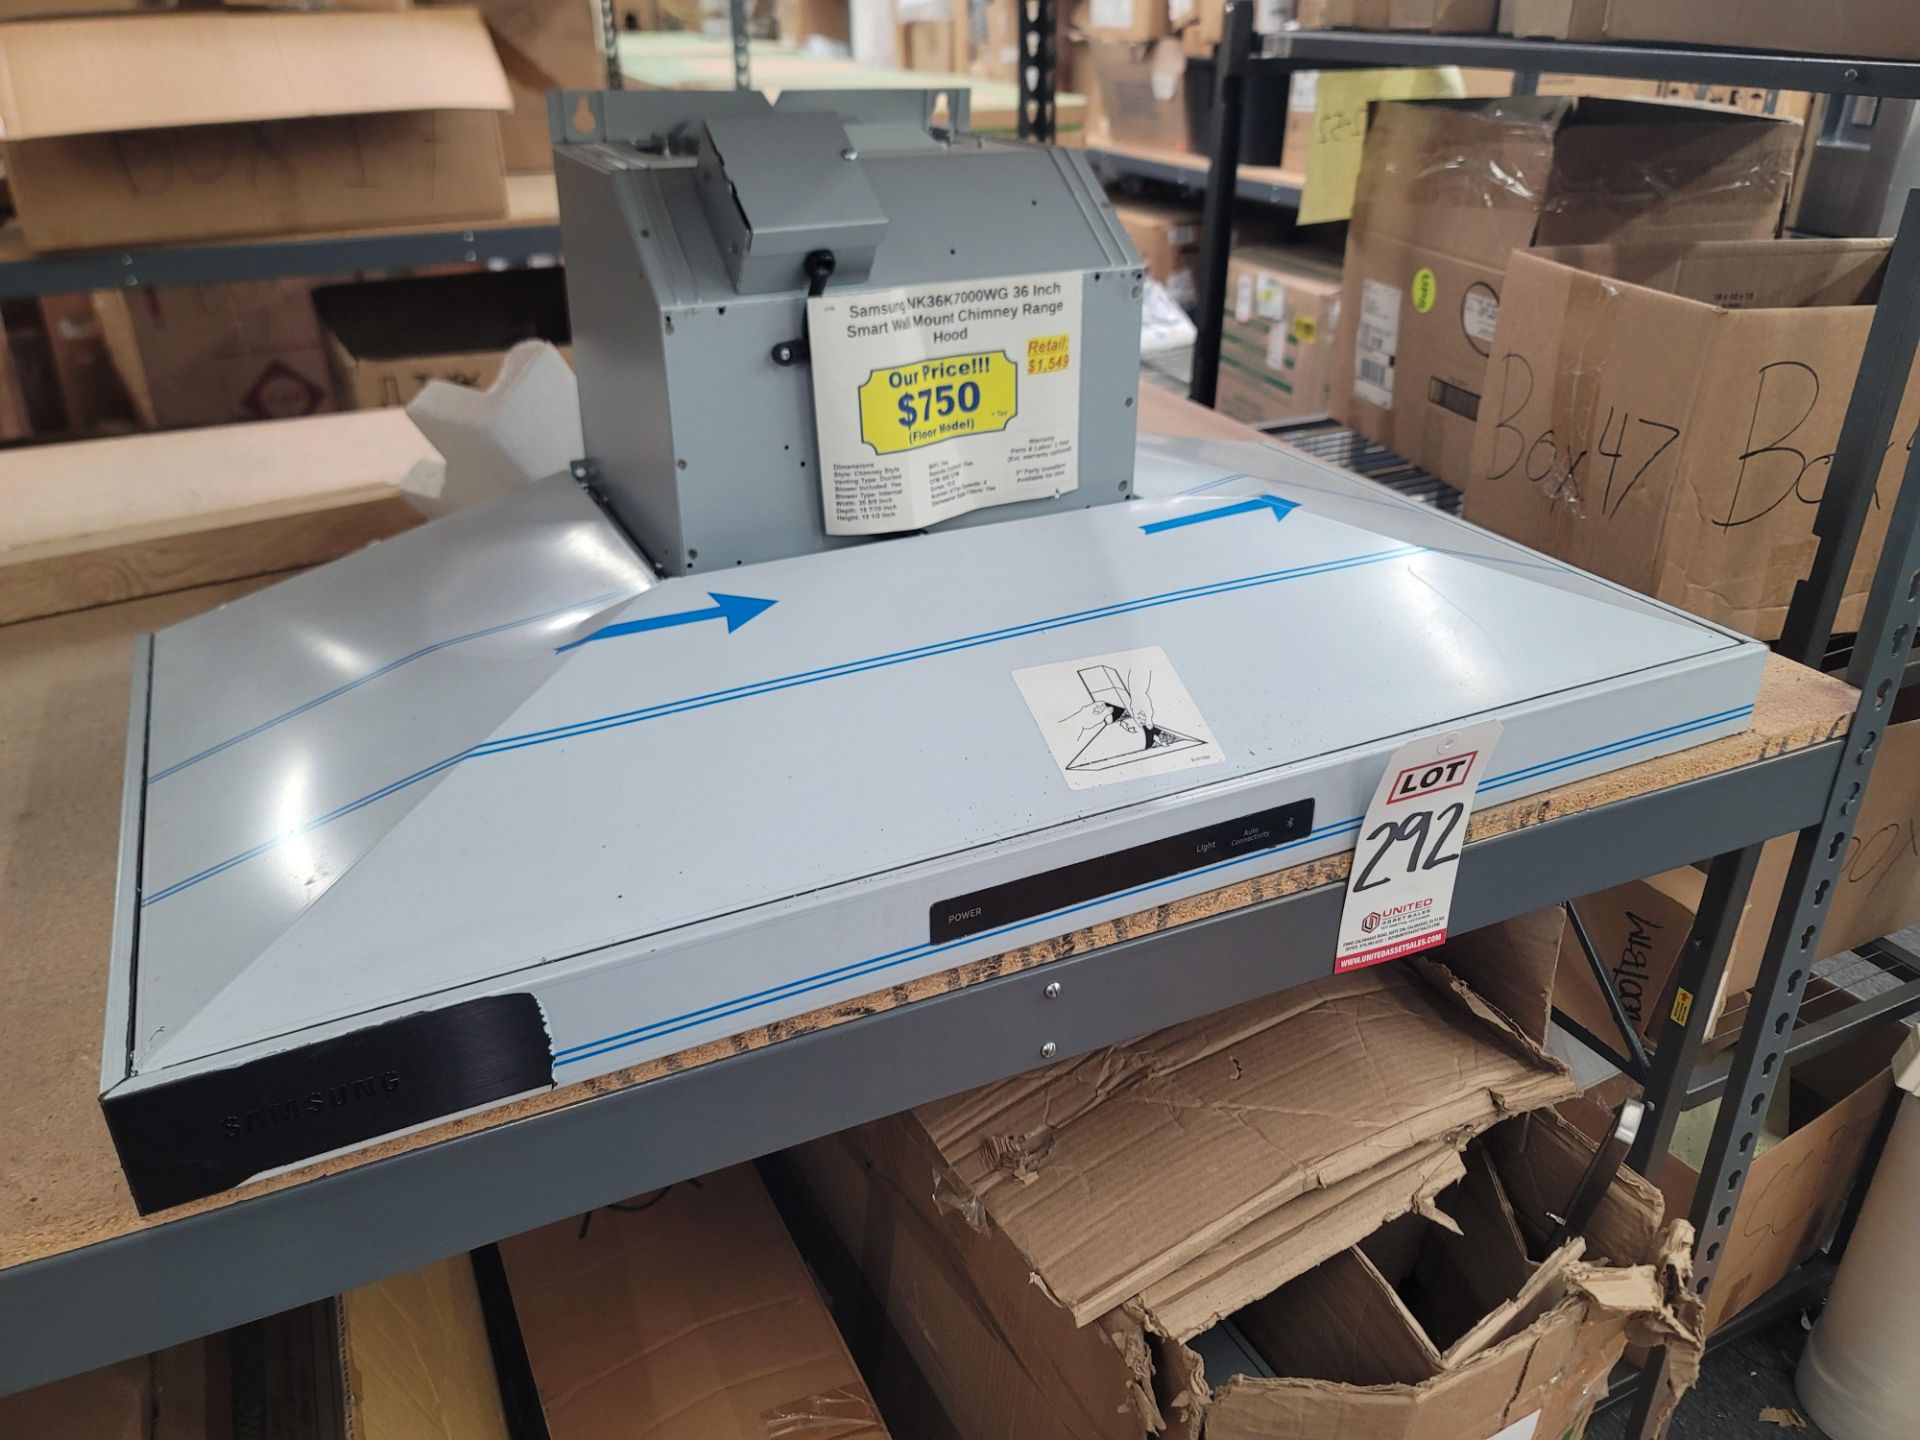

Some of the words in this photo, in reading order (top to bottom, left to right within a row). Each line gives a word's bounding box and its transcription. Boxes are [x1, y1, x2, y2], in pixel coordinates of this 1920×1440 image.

[1013, 285, 1029, 299] 36
[1033, 281, 1061, 297] Inch
[847, 321, 889, 339] Smart
[913, 312, 954, 328] Mount
[958, 307, 1018, 322] Chimney
[1023, 301, 1064, 317] Range
[933, 327, 969, 345] Hood
[888, 370, 919, 389] Our
[921, 357, 991, 382] Price!!!
[1028, 354, 1070, 375] $1,549
[898, 380, 981, 431] $750
[908, 428, 937, 446] (Floor
[938, 418, 975, 435] Model)
[1487, 353, 1587, 516] Box
[1599, 406, 1680, 520] 47
[1399, 760, 1466, 795] LOT
[1196, 841, 1217, 854] Light
[1231, 831, 1271, 847] Connectivity
[1243, 827, 1260, 837] Auto
[1353, 802, 1464, 893] 292
[948, 907, 983, 924] POWER
[1382, 898, 1433, 918] UNITED
[1340, 933, 1442, 969] WWW.UNITEDASSETSALES.COM
[219, 1070, 401, 1138] SAMSUNG
